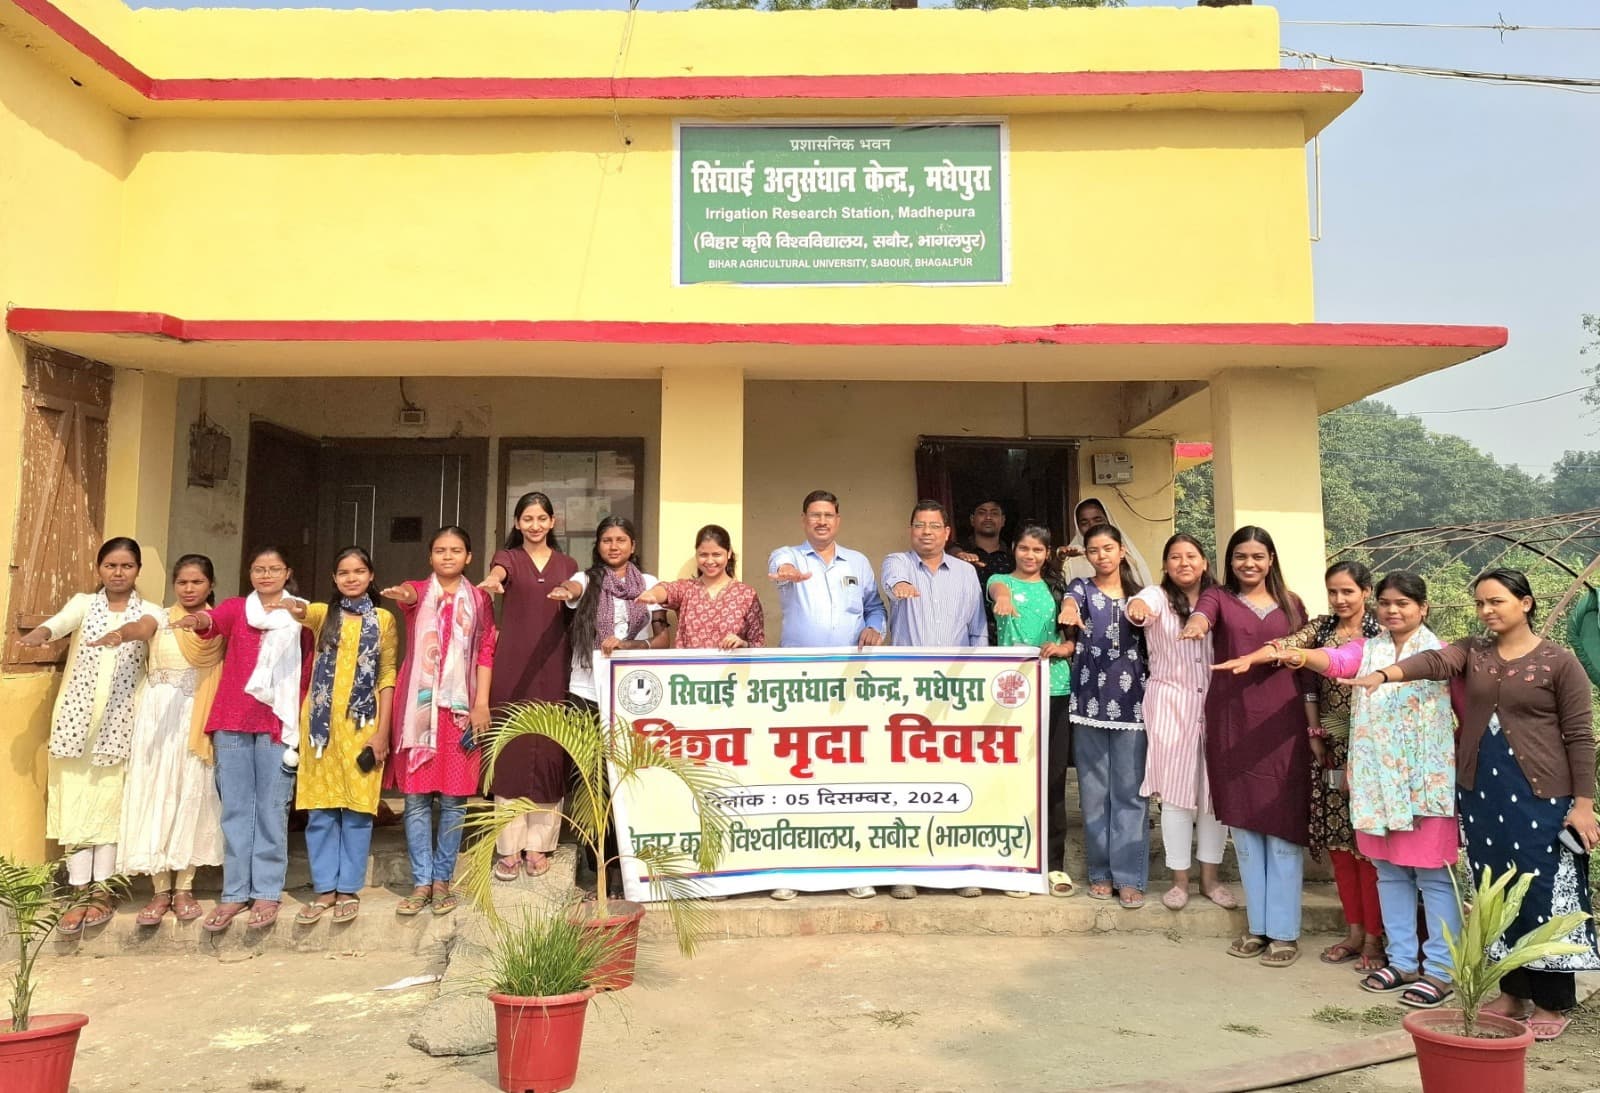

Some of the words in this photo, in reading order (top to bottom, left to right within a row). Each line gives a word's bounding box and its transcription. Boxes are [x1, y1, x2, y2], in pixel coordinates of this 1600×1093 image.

[789, 135, 855, 152] प्रशासनिक
[859, 138, 891, 151] भवन
[691, 159, 755, 197] सिंचाई
[763, 159, 857, 202] अनुसंधान
[862, 159, 915, 198] केन्द्र,
[923, 158, 992, 201] मधेपुरा
[705, 207, 768, 222] Irrigation
[772, 206, 837, 220] Research
[841, 206, 895, 220] Station,
[898, 206, 976, 221] Madhepura
[693, 231, 740, 254] (बिहार
[741, 231, 773, 254] कृषि
[775, 230, 868, 249] विश्वविद्यालय,
[917, 229, 986, 254] भागलपुर)
[708, 258, 738, 269] BIHAR
[739, 258, 811, 269] AGRICULTURAL
[812, 258, 869, 269] UNIVERSITY,
[870, 258, 912, 269] SABOUR,
[914, 257, 973, 267] BHAGALPUR
[668, 672, 738, 708] सिचाई
[746, 670, 847, 712] अनुसंधान
[854, 670, 909, 706] केन्द्र,
[913, 669, 986, 711] मधेपुरा
[768, 725, 869, 779] मृदा
[884, 713, 1022, 764] दिवस
[785, 793, 810, 806] 05
[816, 787, 899, 807] दिसम्बर,
[907, 791, 960, 805] 2024
[729, 817, 861, 853] विश्वविद्यालय,
[868, 816, 921, 849] सबौर
[926, 815, 1032, 859] (भागलपुर)
